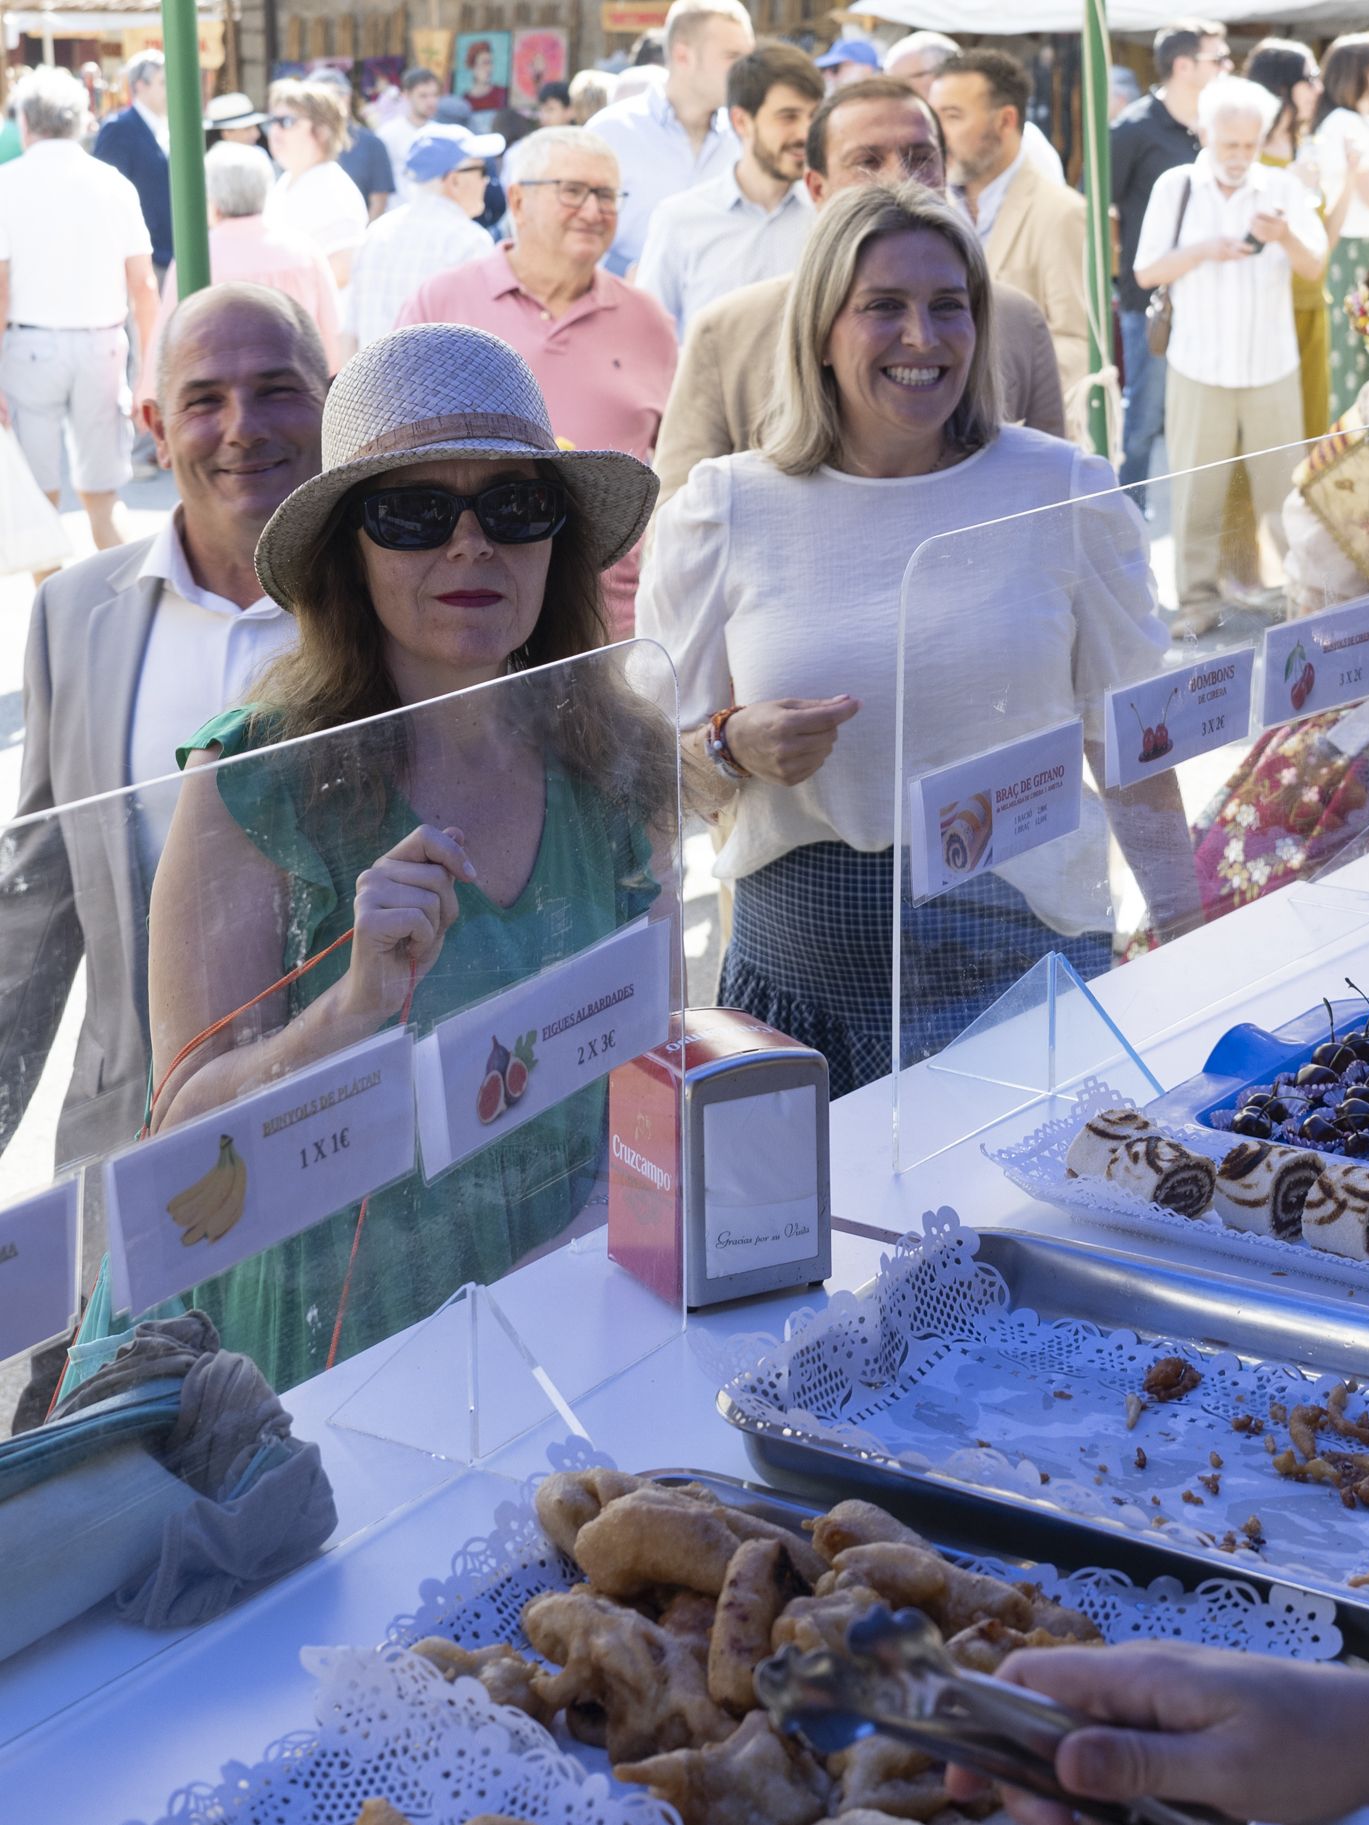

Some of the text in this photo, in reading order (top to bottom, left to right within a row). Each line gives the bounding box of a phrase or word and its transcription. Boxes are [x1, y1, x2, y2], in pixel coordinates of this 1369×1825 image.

[1190, 664, 1235, 693] BOMBONS
[1202, 721, 1207, 736] 3
[1207, 718, 1214, 734] X
[995, 764, 1065, 803] BRAÇ DE GITANO
[541, 983, 635, 1042] FIGUES ALBARDADES
[577, 1029, 616, 1065] 2 X 3€
[262, 1098, 318, 1139] BUNYOLS
[318, 1091, 336, 1111] DE
[300, 1126, 350, 1169] 1 X 1€
[612, 1134, 671, 1191] Cruzcampo
[715, 1230, 752, 1249] Gracias
[754, 1235, 769, 1246] por
